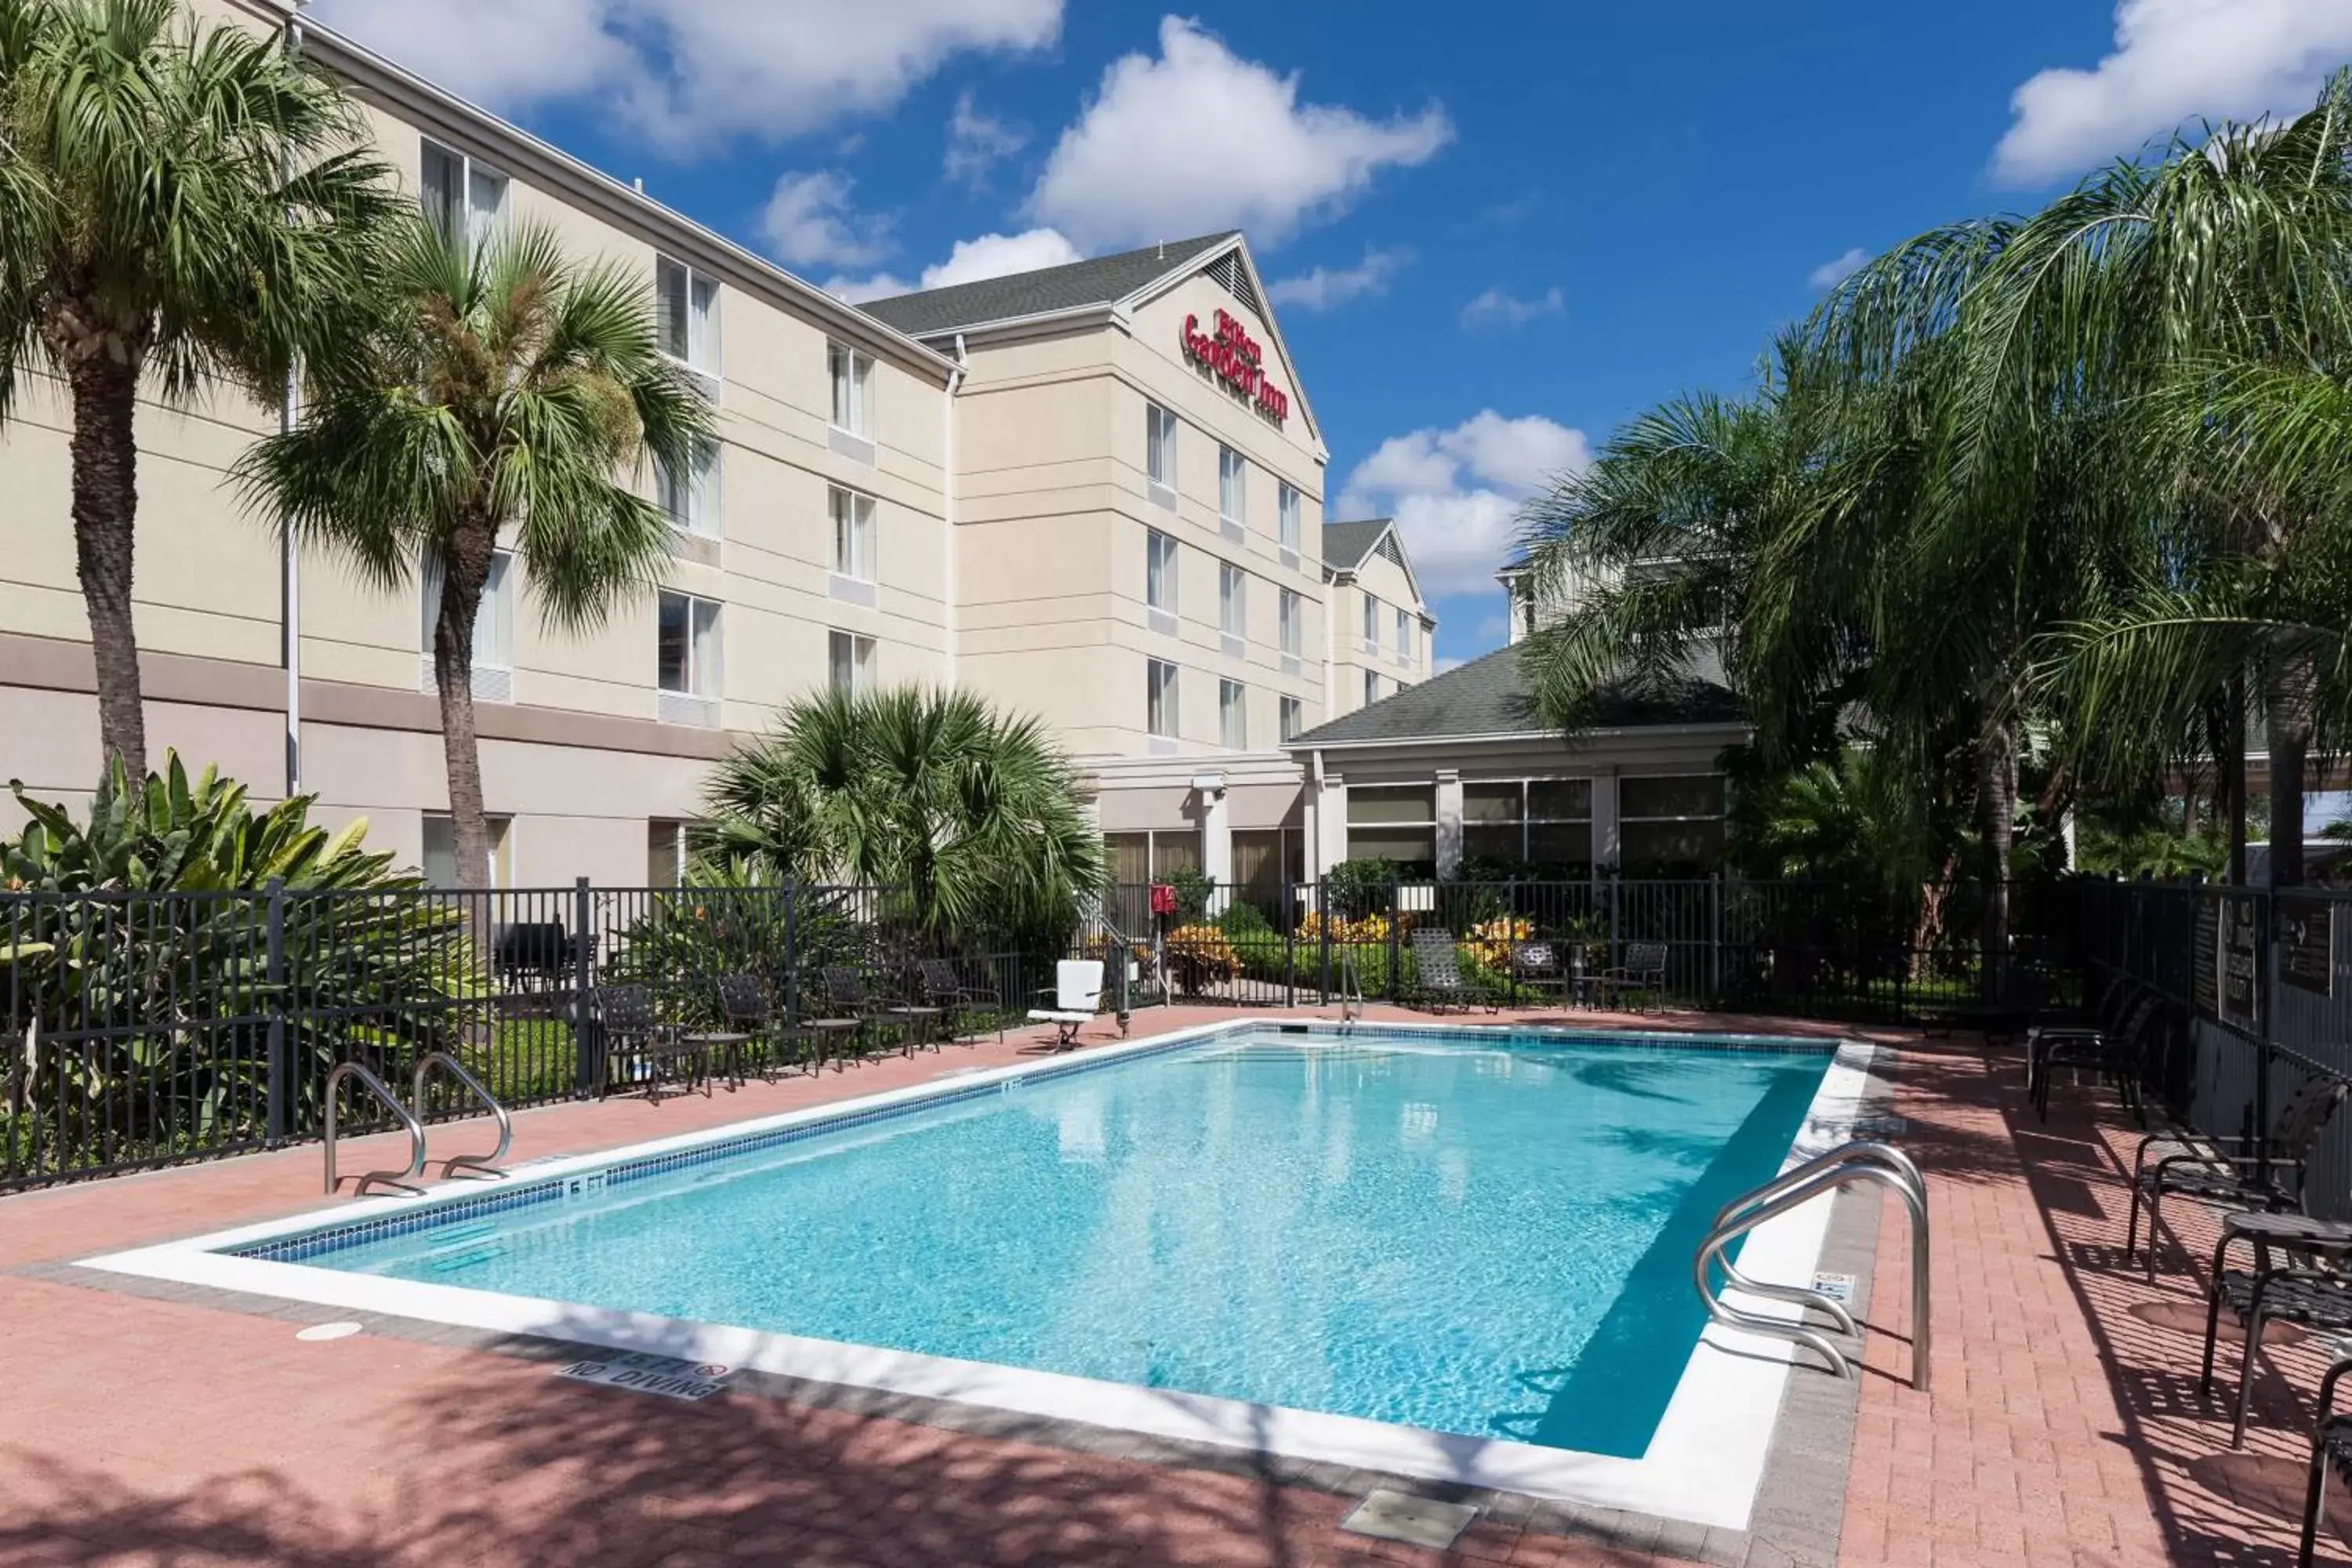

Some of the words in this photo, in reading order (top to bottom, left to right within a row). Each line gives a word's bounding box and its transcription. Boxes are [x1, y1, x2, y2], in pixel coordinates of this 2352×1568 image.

[1181, 314, 1255, 396] Garden
[1256, 367, 1288, 419] Inn
[587, 1175, 604, 1190] FT
[561, 1362, 608, 1377] NO
[609, 1370, 717, 1397] DIVING
